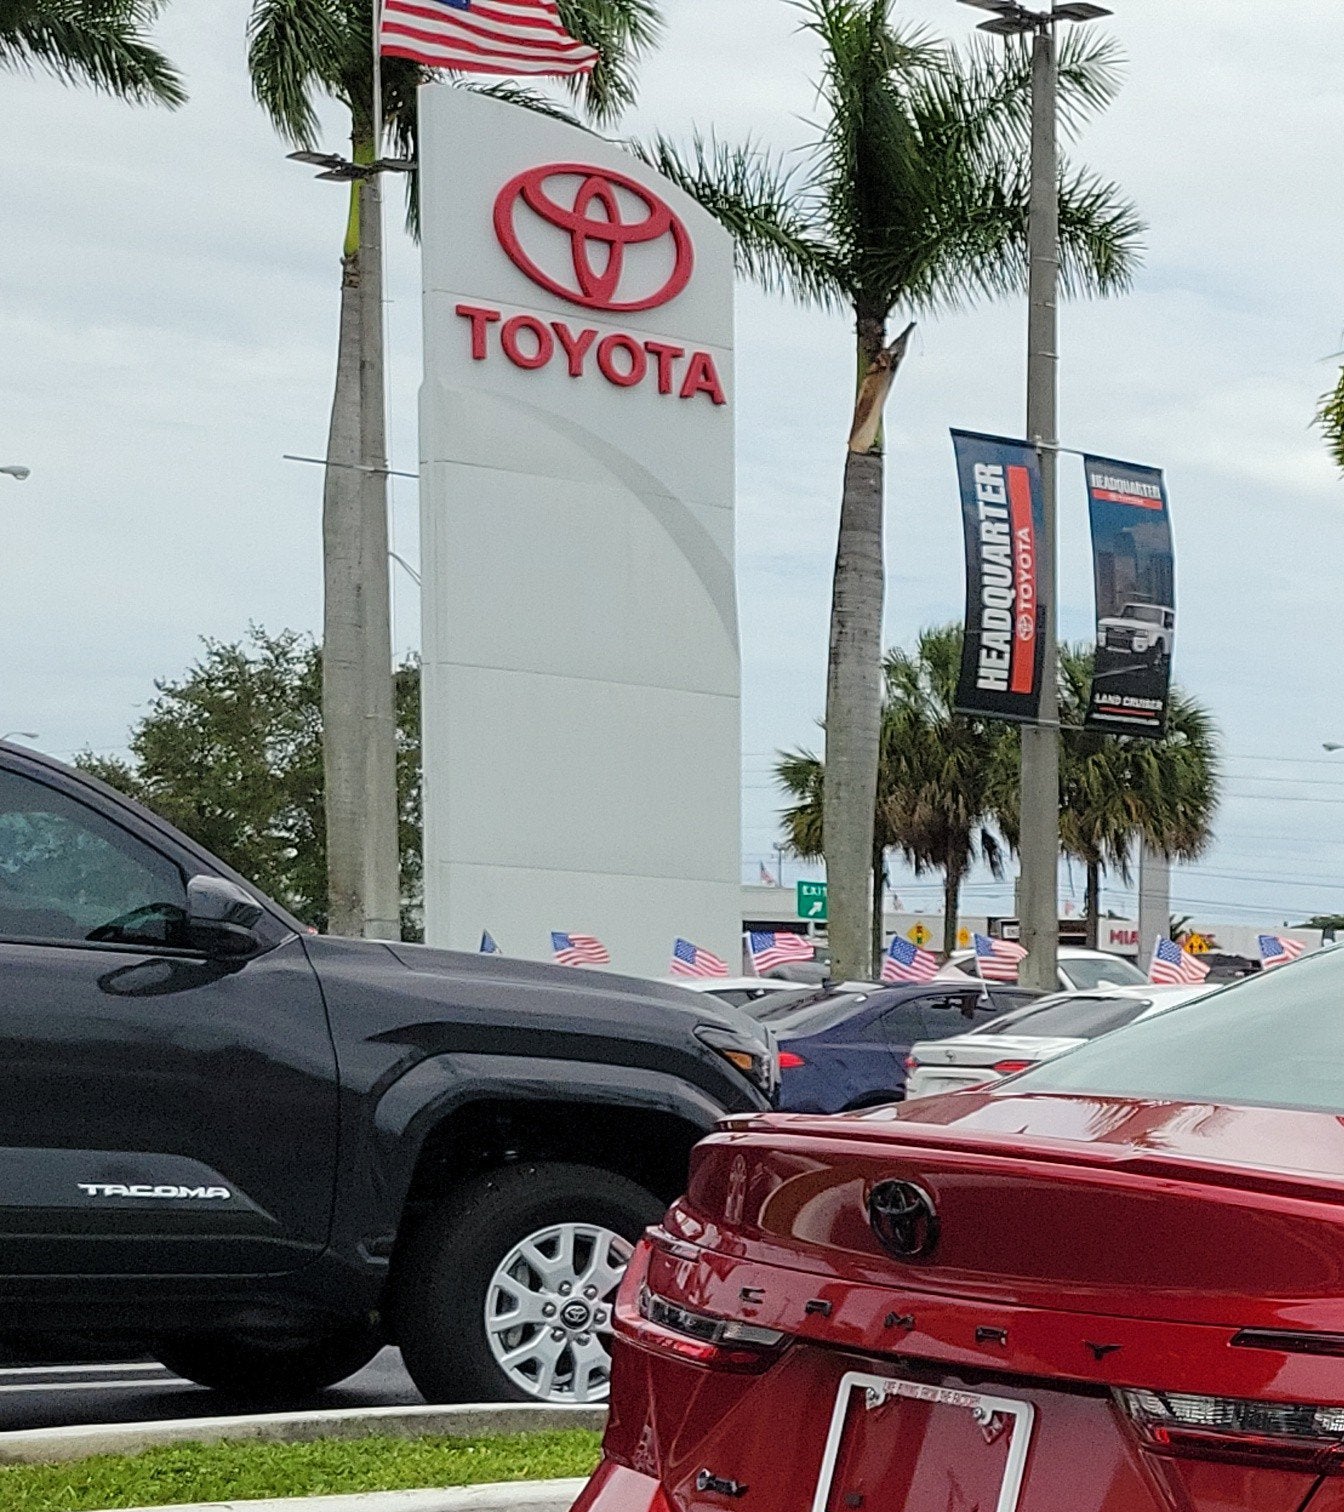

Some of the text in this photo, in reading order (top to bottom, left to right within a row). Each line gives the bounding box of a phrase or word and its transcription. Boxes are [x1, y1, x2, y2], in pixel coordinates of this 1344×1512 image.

[455, 303, 727, 406] TOYOTA
[974, 462, 1015, 692] HEADQUARTER
[1015, 527, 1034, 612] TOYOTA
[77, 1182, 231, 1200] TACOMA
[739, 1286, 1123, 1361] CAMRY
